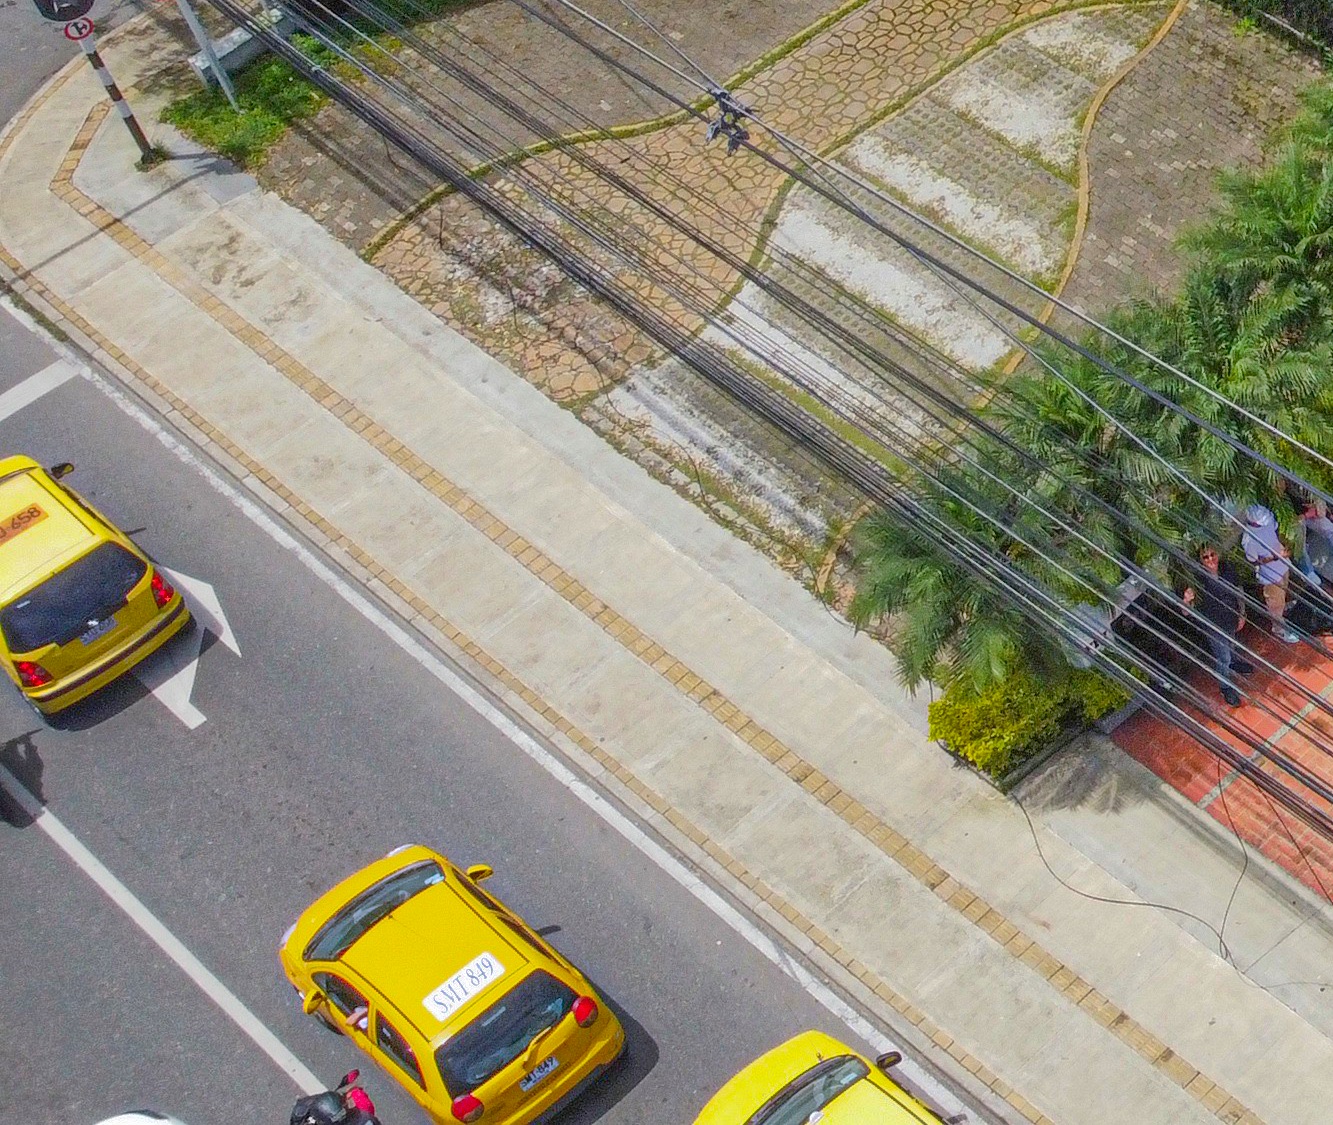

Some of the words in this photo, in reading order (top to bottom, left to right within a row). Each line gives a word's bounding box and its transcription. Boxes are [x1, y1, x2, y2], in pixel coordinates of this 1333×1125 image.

[11, 507, 41, 530] 658
[433, 975, 468, 1014] SMT
[465, 957, 494, 987] 849
